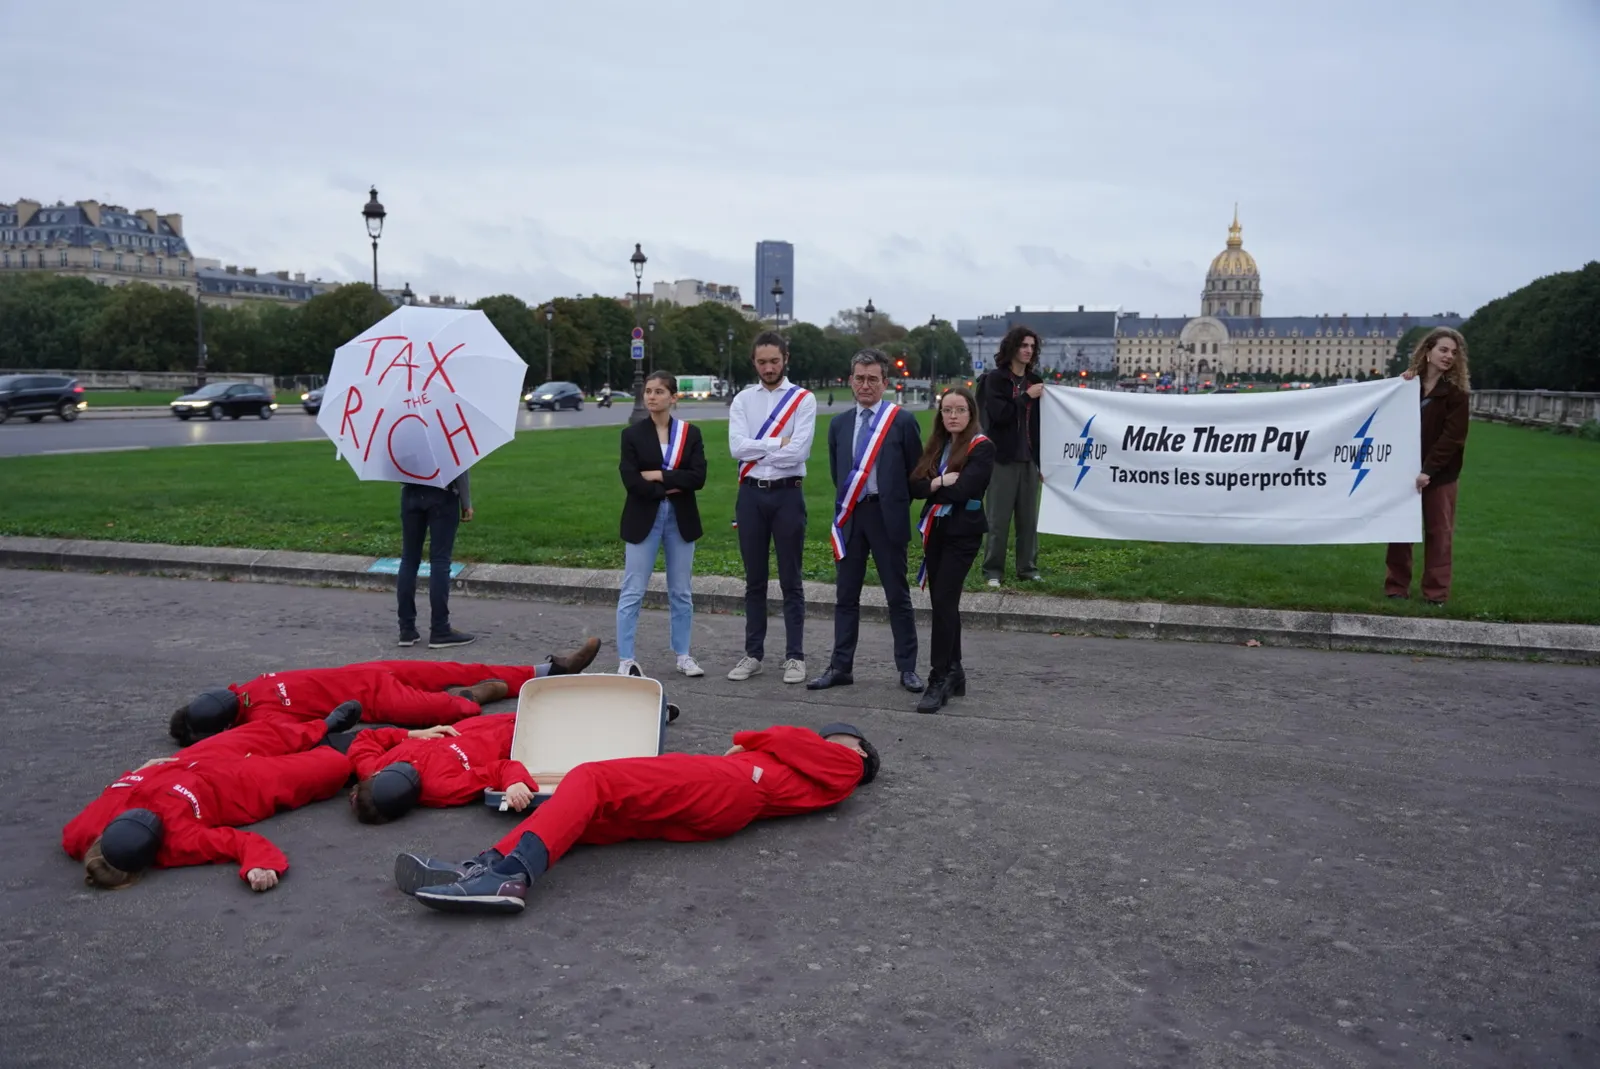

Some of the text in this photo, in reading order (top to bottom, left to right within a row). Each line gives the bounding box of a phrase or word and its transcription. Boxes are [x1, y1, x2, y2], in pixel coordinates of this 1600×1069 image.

[358, 335, 466, 393] TAX
[403, 392, 432, 409] THE
[340, 385, 479, 480] RICH
[1122, 425, 1310, 461] Make Them Pay
[1063, 442, 1107, 460] POWER UP
[1333, 443, 1392, 463] POWER UP
[1109, 465, 1327, 491] Taxons les superprofits
[173, 784, 201, 817] CLIMATE
